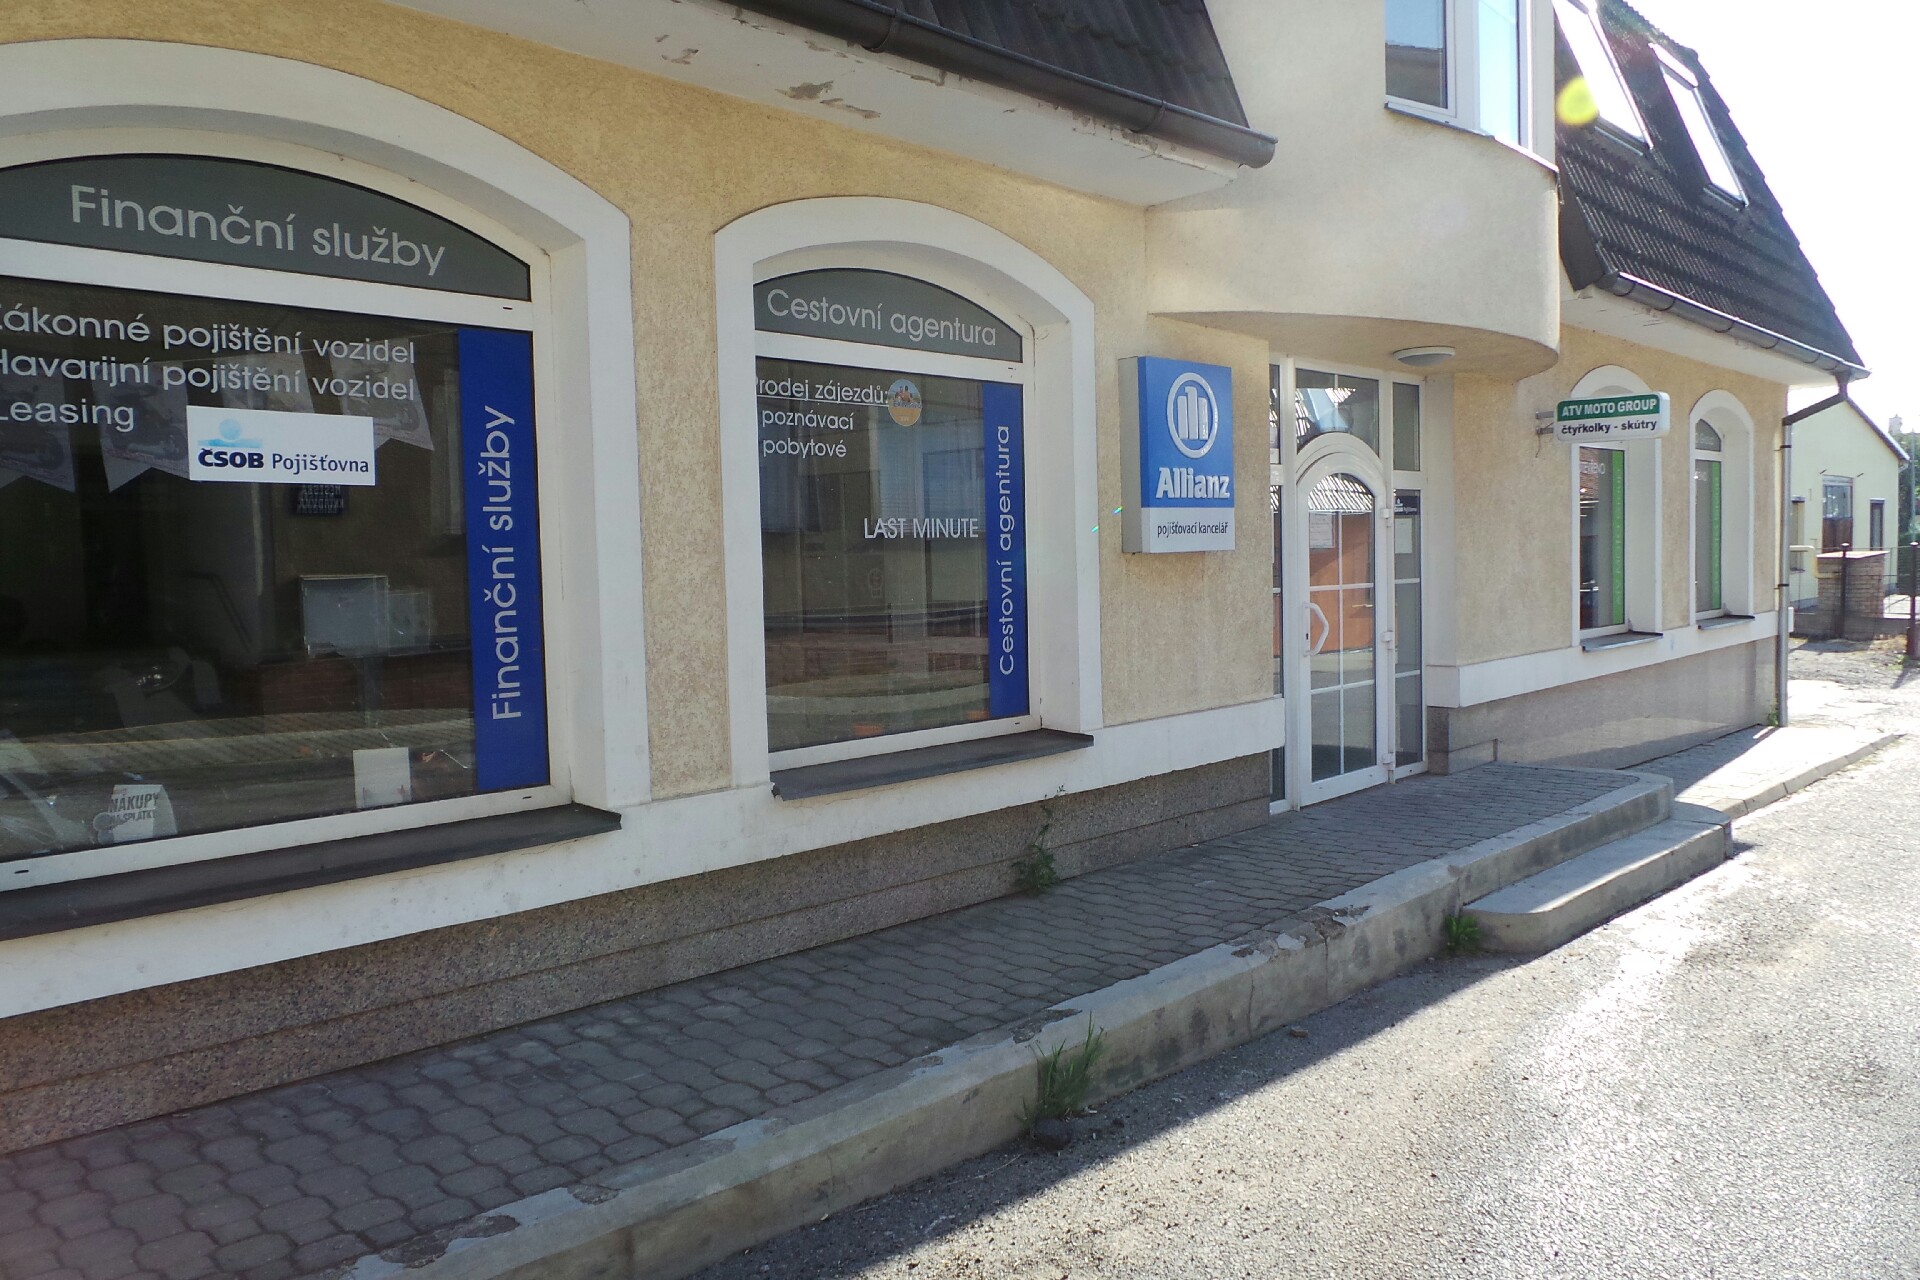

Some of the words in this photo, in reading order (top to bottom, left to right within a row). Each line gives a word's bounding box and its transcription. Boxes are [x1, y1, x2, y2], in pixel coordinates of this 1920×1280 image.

[70, 184, 296, 252] Finanční
[311, 222, 446, 276] služby
[767, 288, 883, 330] Cestovní
[890, 312, 997, 346] agentura
[0, 303, 151, 342] ákonné
[163, 322, 302, 355] pojištění
[312, 337, 415, 364] vozidel
[162, 362, 302, 394] pojištění
[312, 375, 415, 401] vozidel
[756, 377, 809, 401] rodej
[815, 380, 889, 404] zájezdů:
[762, 409, 854, 430] poznávací
[1561, 405, 1582, 417] ATV
[1584, 402, 1615, 415] MOTO
[1617, 399, 1657, 412] GROUP
[1561, 423, 1611, 436] čtyřkolky
[1620, 420, 1657, 431] skútry
[198, 447, 265, 469] ČSOB
[272, 453, 369, 475] Pojišťovna
[763, 437, 847, 459] pobytové
[478, 405, 516, 531] služby
[1155, 467, 1230, 499] Allianz
[995, 426, 1015, 551] agentura
[864, 518, 906, 539] LAST
[913, 518, 979, 539] MINUTE
[1157, 521, 1197, 538] pojišťovací
[1198, 521, 1228, 534] kancelář
[482, 545, 522, 720] Finanční
[996, 559, 1014, 675] Cestovní
